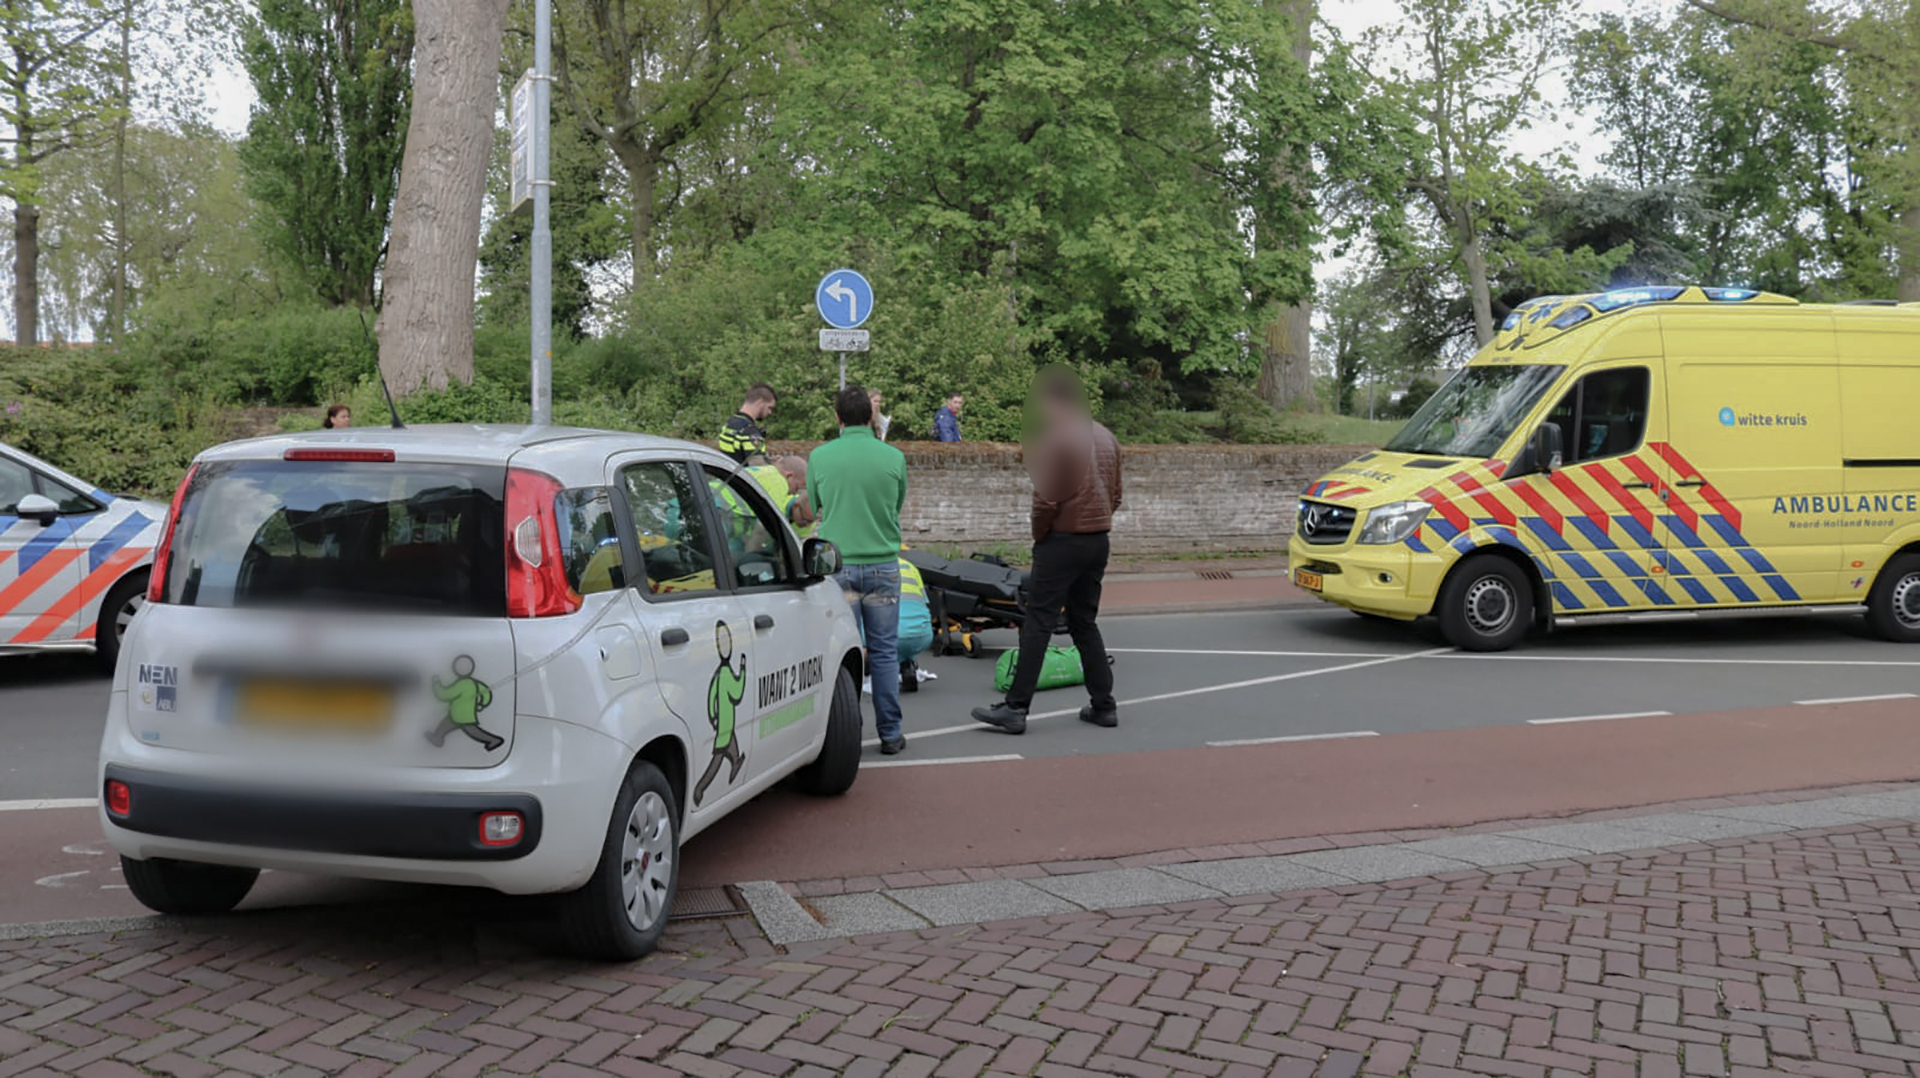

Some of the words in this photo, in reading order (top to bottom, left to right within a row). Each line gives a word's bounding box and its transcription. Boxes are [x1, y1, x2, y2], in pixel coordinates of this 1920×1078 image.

[1738, 412, 1773, 426] witte
[1775, 412, 1808, 426] kruis
[1772, 494, 1918, 514] AMBULANCE
[1863, 518, 1895, 528] Noord
[139, 663, 178, 686] NEN
[758, 666, 788, 709] WANT
[789, 664, 797, 695] 2
[798, 654, 824, 692] WORK
